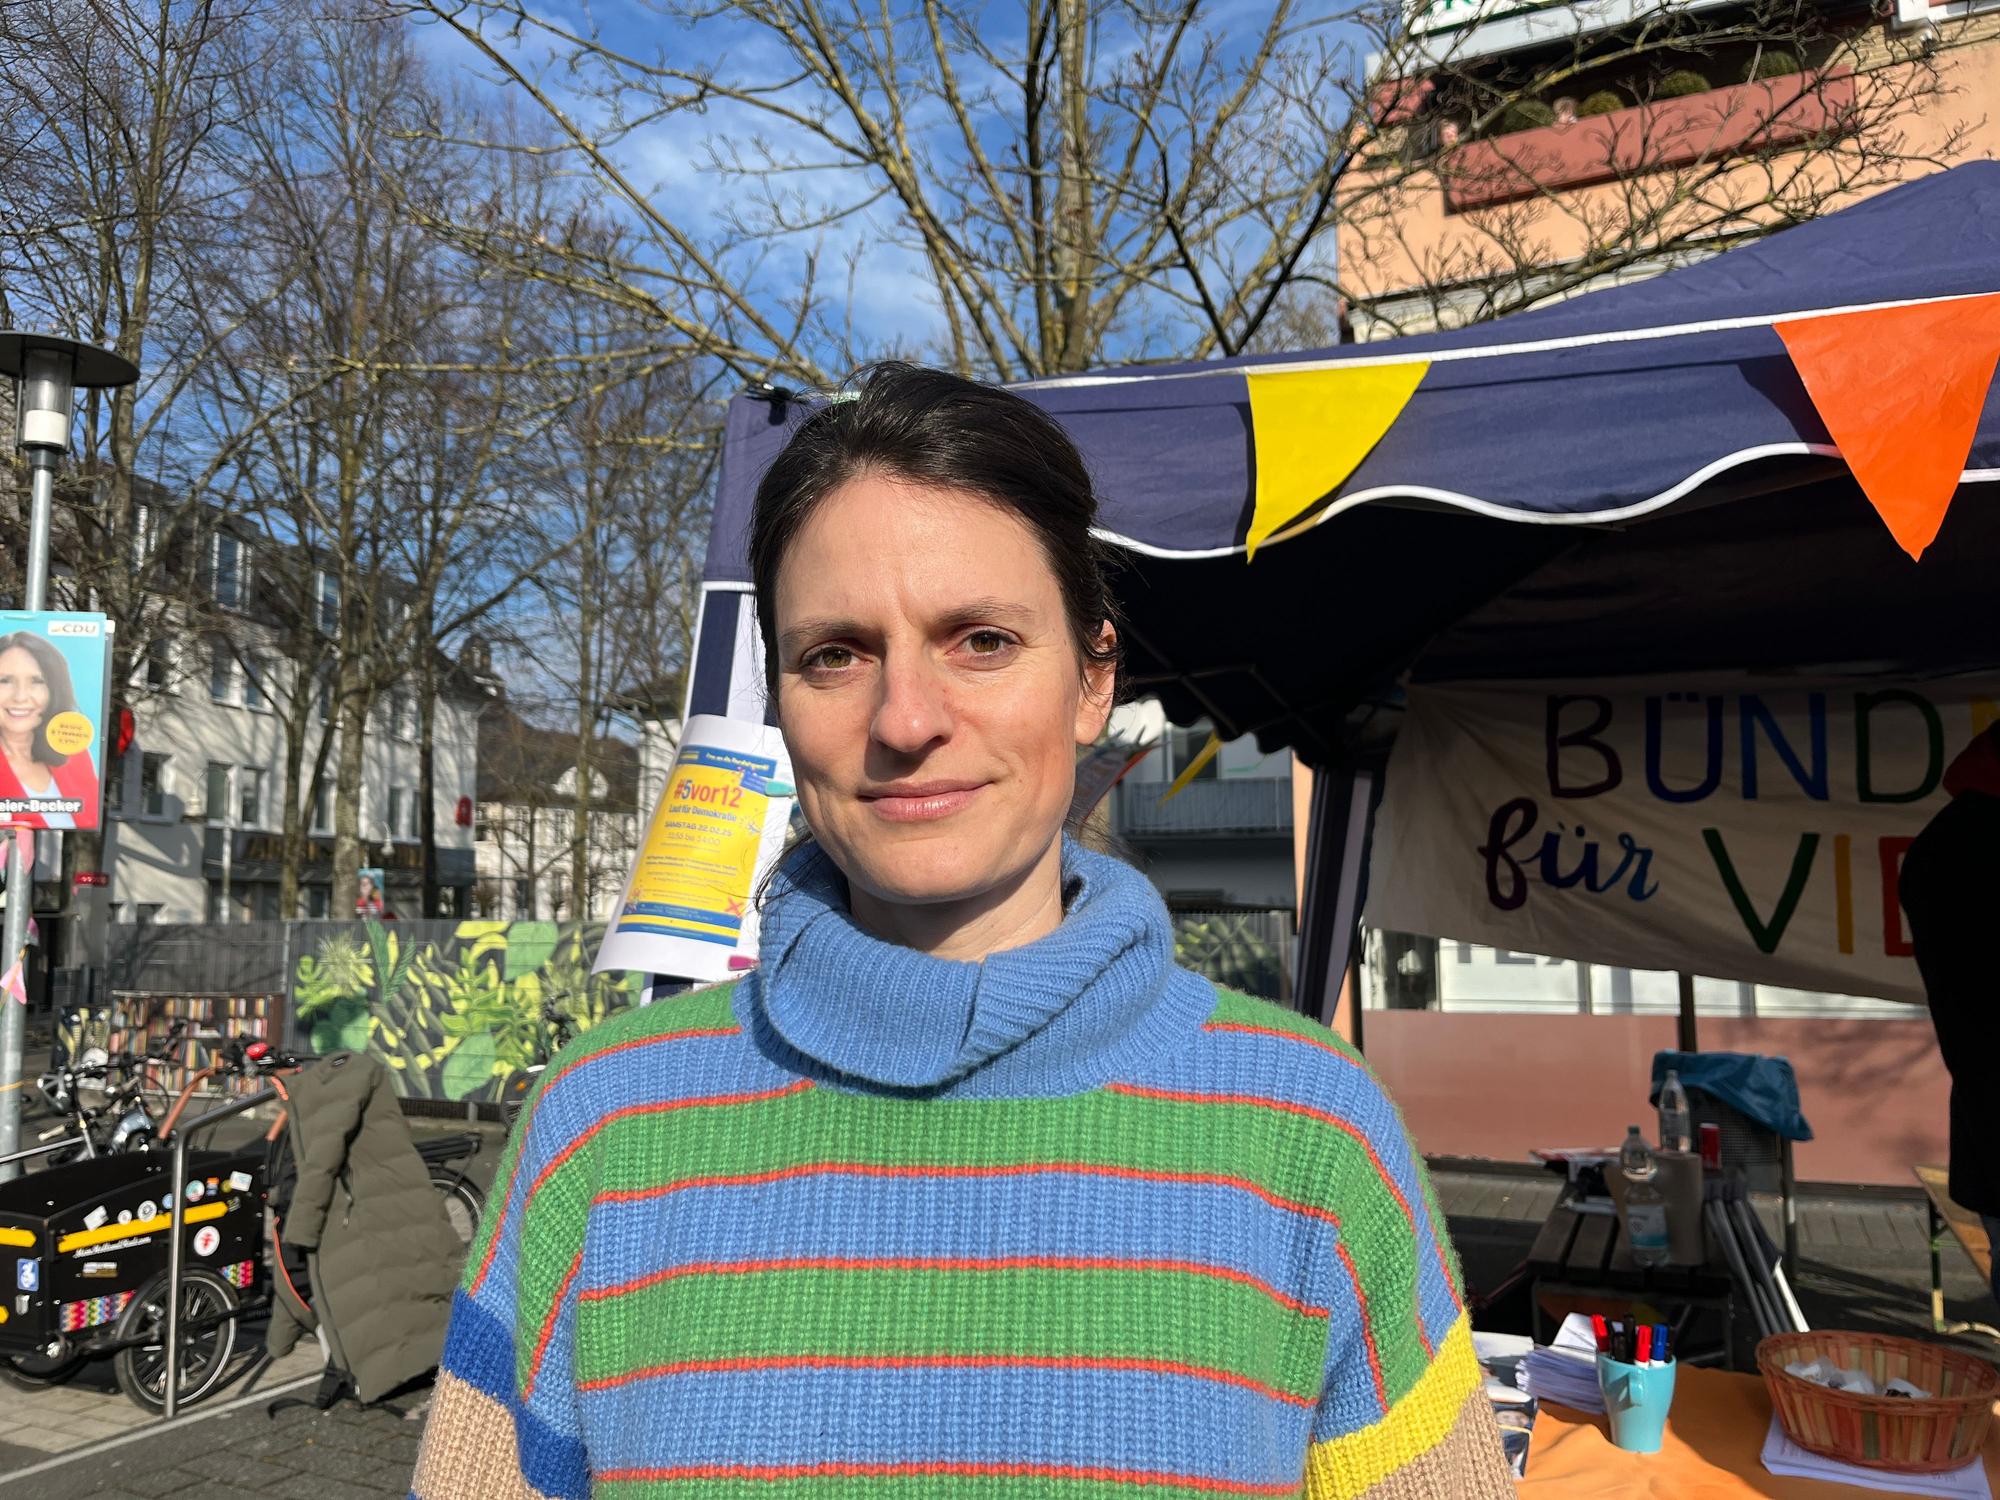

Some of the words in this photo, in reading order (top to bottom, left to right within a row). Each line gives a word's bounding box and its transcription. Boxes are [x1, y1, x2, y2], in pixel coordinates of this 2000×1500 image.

[63, 623, 96, 634] CDU
[1545, 690, 2000, 803] BÜND
[673, 779, 744, 808] #5vor12
[1477, 797, 1659, 911] für
